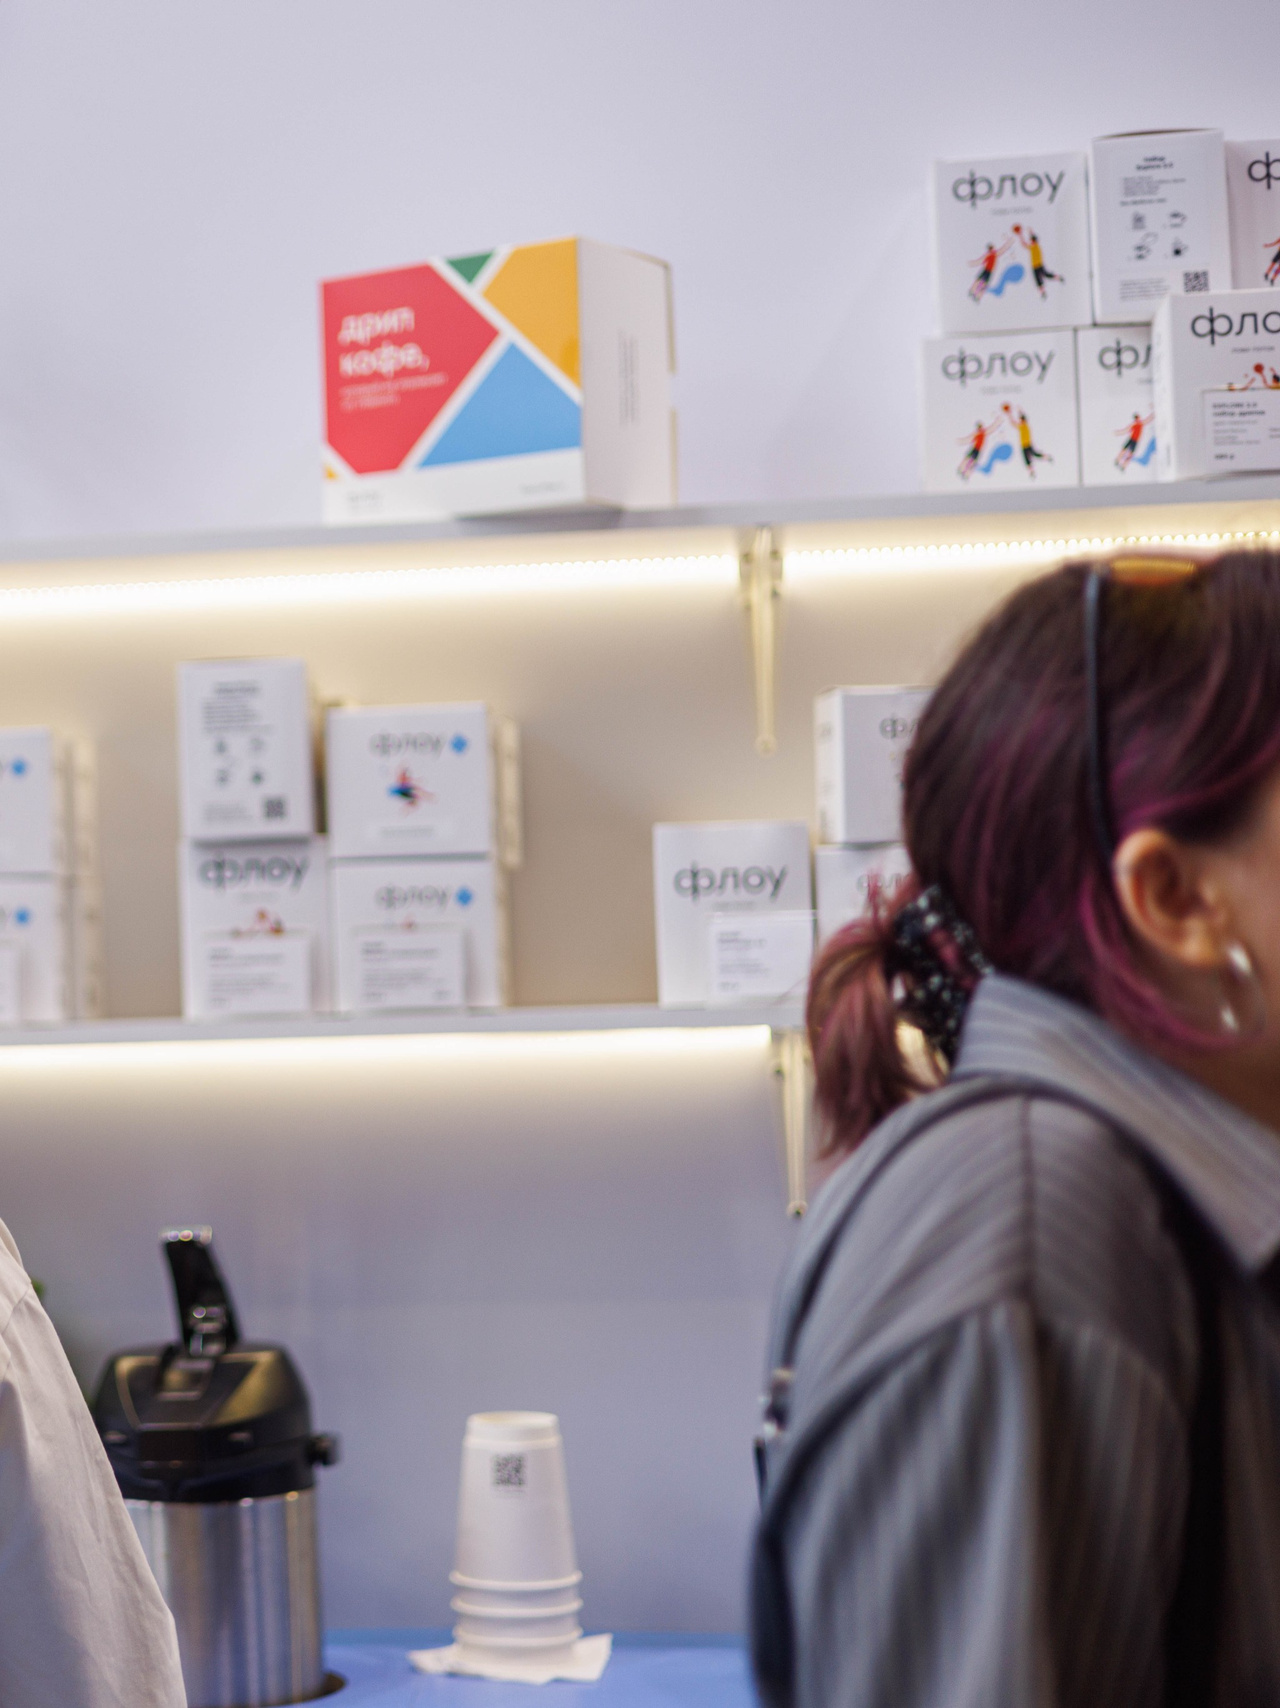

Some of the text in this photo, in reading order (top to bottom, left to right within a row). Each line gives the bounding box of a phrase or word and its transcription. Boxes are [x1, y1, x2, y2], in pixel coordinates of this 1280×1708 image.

[953, 170, 1064, 207] флоу
[338, 306, 415, 345] дрип
[942, 349, 1054, 387] флоу
[674, 860, 787, 901] флоу
